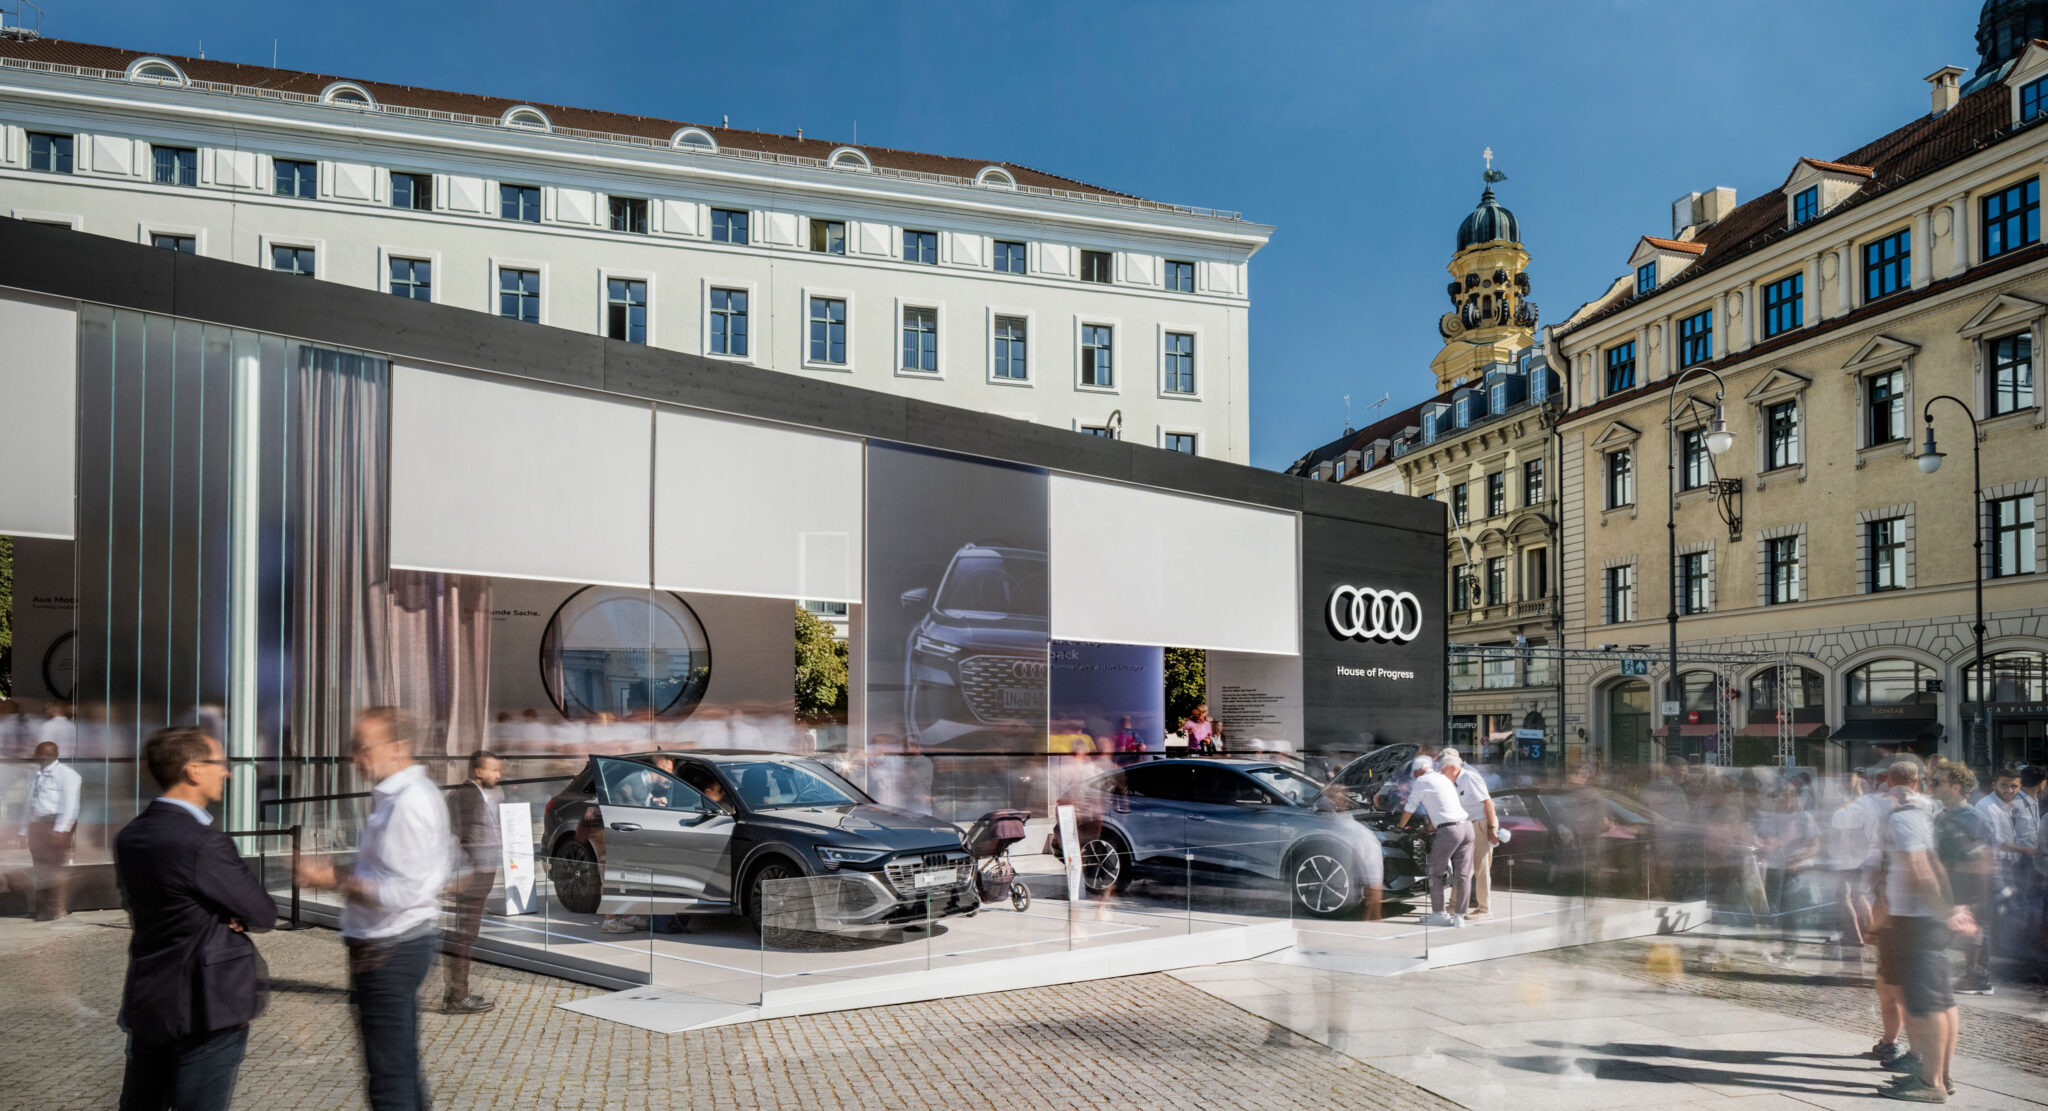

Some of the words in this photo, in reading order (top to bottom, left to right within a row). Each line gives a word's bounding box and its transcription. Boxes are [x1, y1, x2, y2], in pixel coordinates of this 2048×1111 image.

[1337, 665, 1365, 677] House
[1366, 667, 1377, 677] of
[1378, 668, 1414, 680] Progress
[1531, 744, 1541, 759] 3
